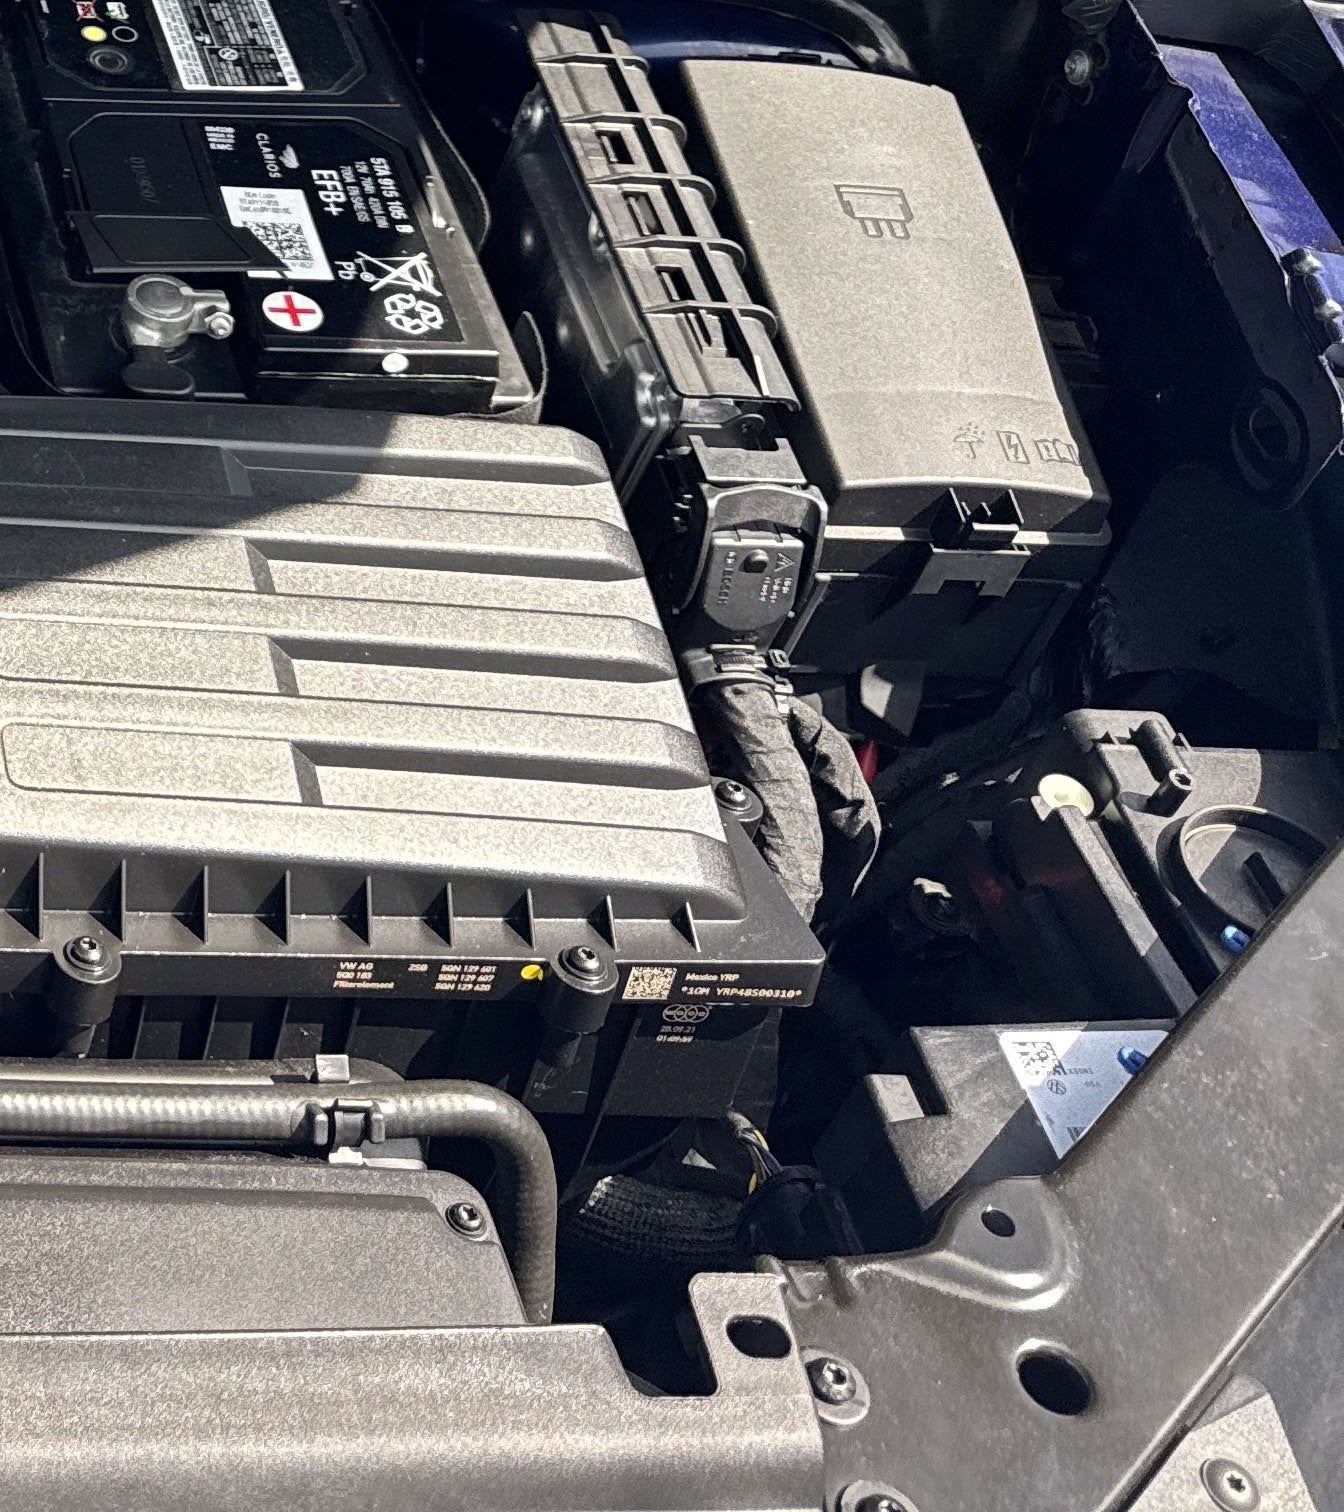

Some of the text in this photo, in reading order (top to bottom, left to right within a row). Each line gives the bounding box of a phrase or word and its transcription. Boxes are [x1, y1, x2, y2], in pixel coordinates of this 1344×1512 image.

[255, 133, 283, 179] CLARIOS
[354, 161, 371, 174] 12V
[369, 157, 393, 176] 5TA
[311, 169, 347, 217] EFB+
[377, 177, 401, 198] 915
[385, 200, 409, 220] 105
[333, 260, 359, 280] Pb
[339, 962, 374, 971] VW AG
[719, 973, 741, 982] YRP
